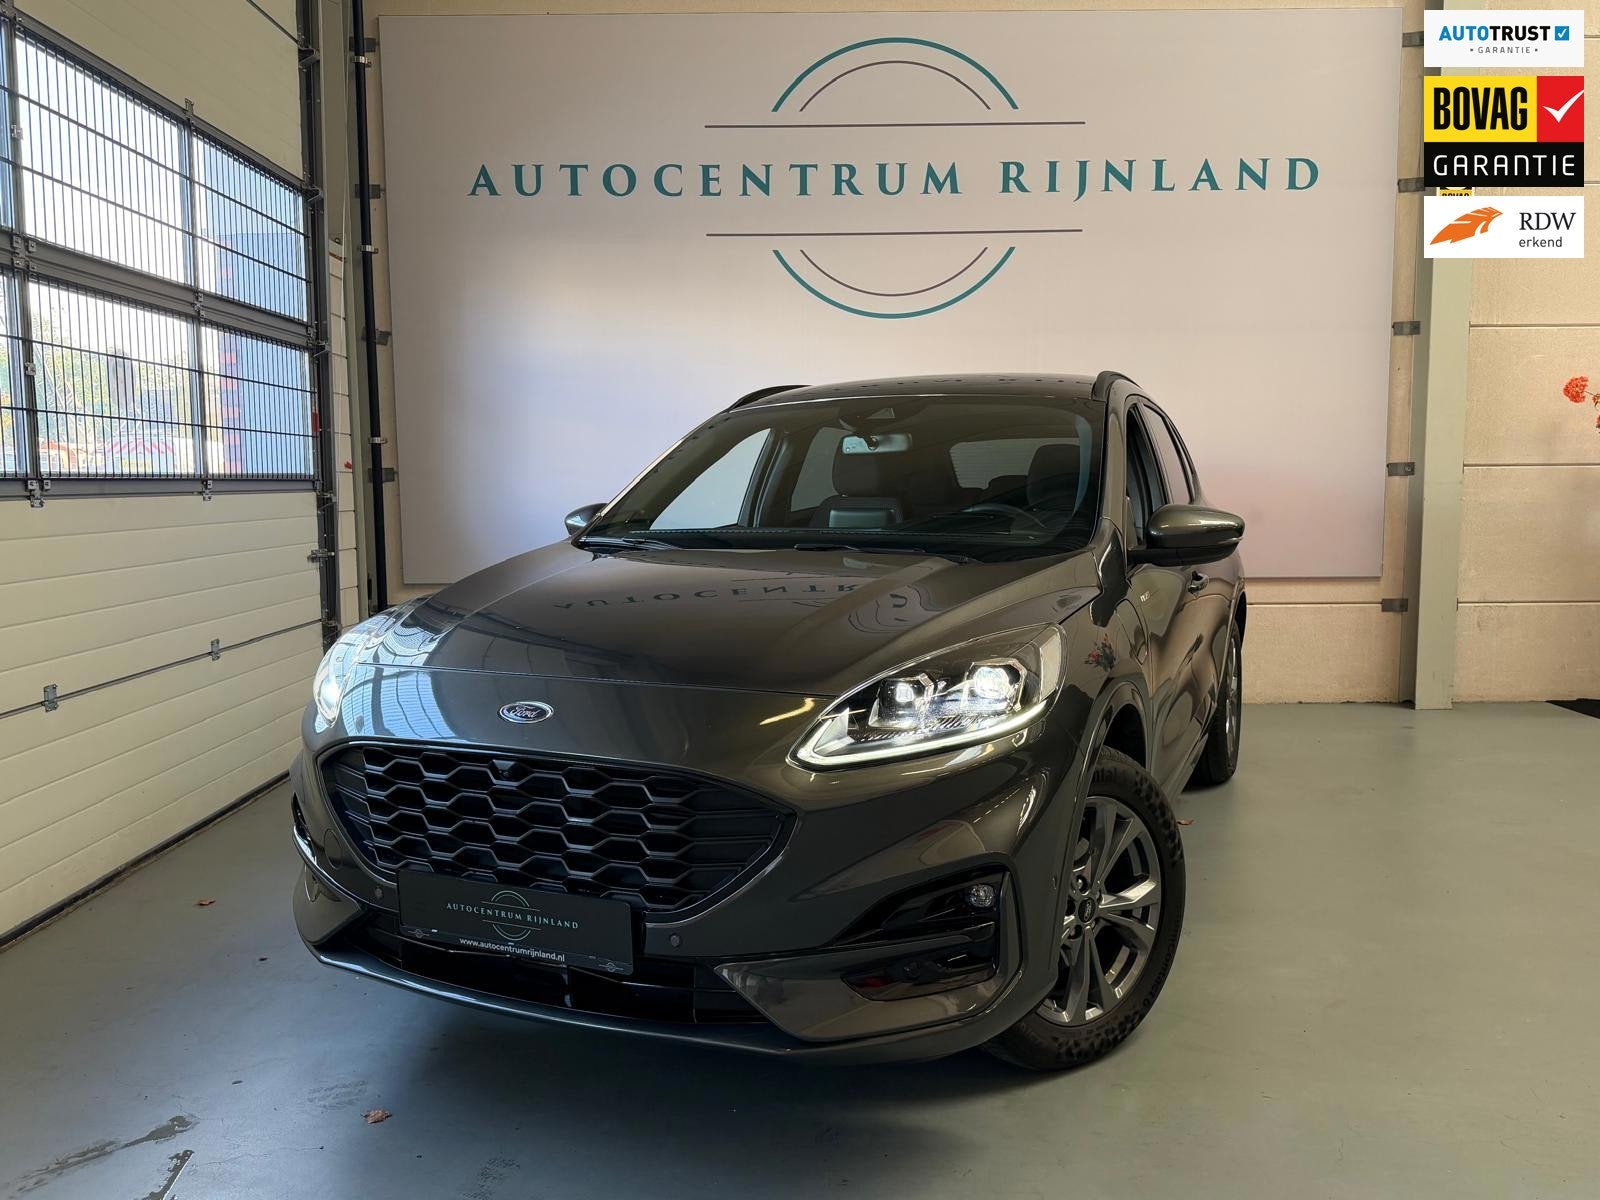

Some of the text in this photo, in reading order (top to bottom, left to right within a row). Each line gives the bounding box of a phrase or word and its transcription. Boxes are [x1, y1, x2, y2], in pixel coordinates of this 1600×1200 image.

[467, 157, 1320, 202] AUTOCENTRUM RIJNLAND
[446, 902, 579, 930] AUTOCENTRUM RIJNLAND
[459, 937, 566, 962] www.autocentrumrijnland.nl
